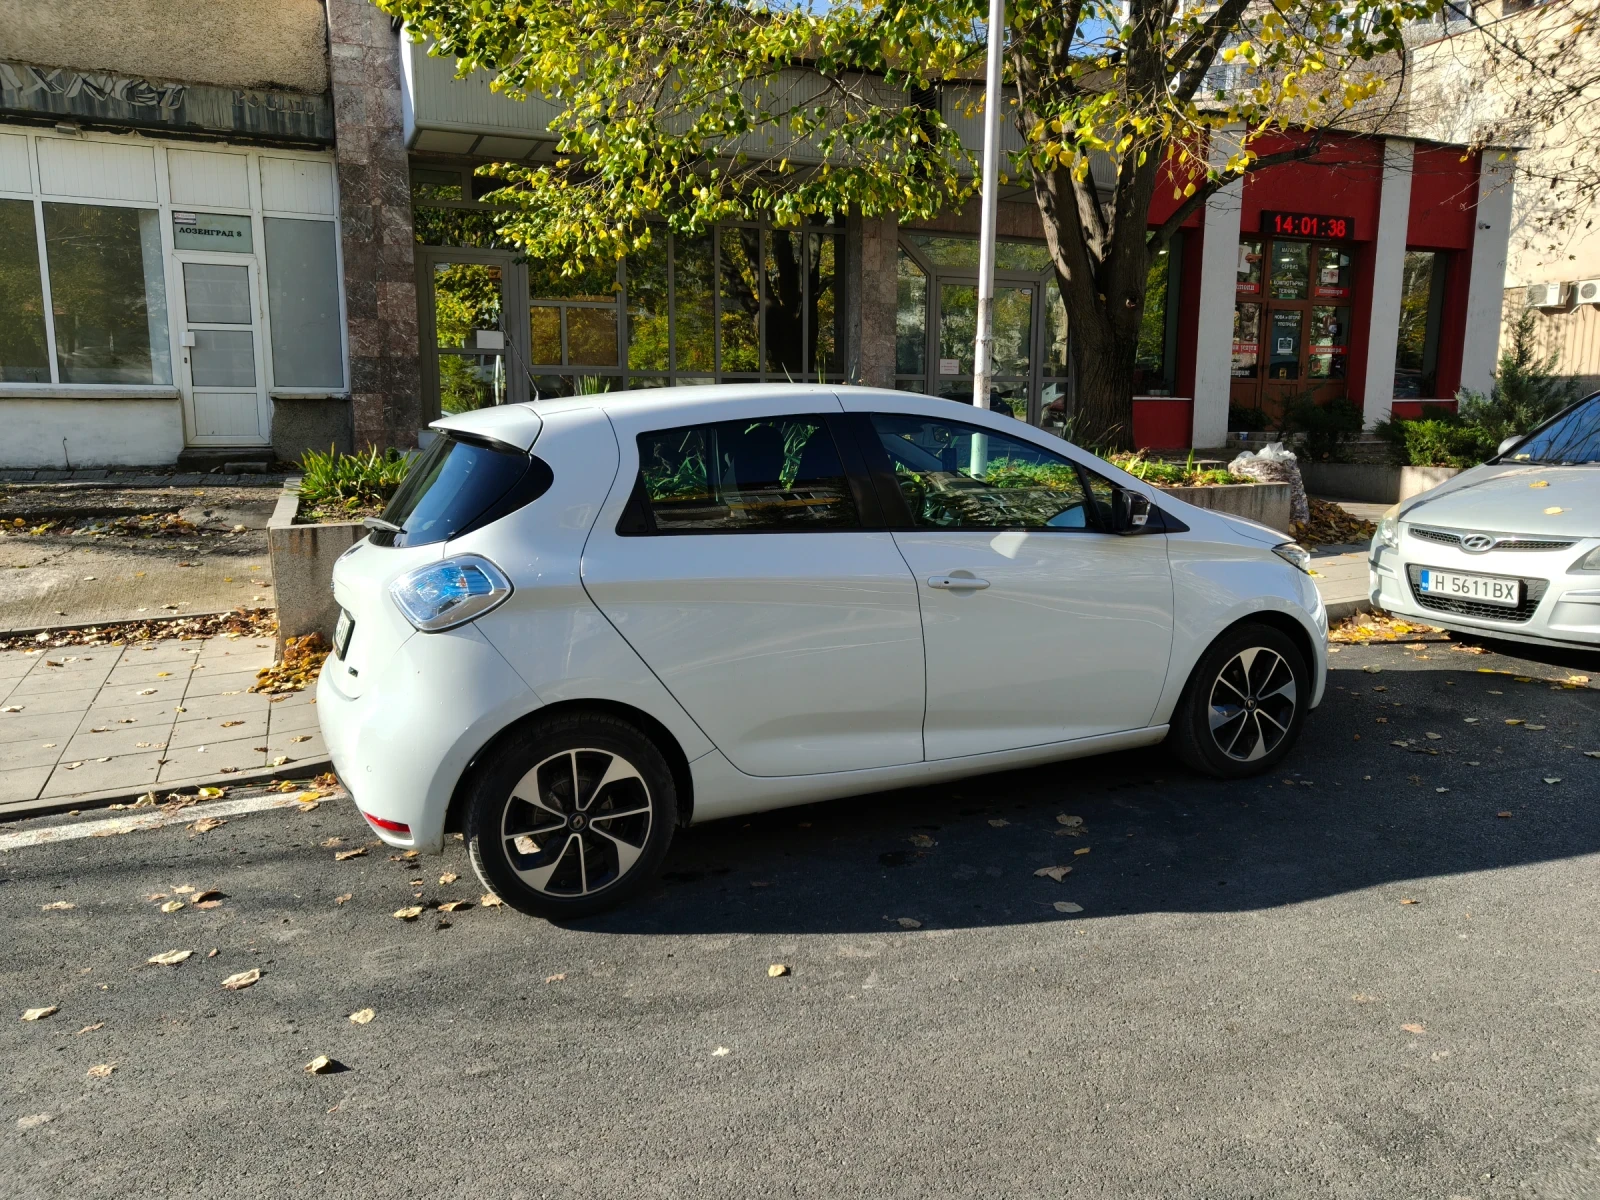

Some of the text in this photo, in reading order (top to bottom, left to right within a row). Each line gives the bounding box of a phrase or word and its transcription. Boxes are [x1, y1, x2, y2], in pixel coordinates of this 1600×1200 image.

[179, 227, 234, 238] ЛОЗЕНГРАД
[1275, 215, 1346, 237] 14:01:38
[1435, 574, 1445, 591] H
